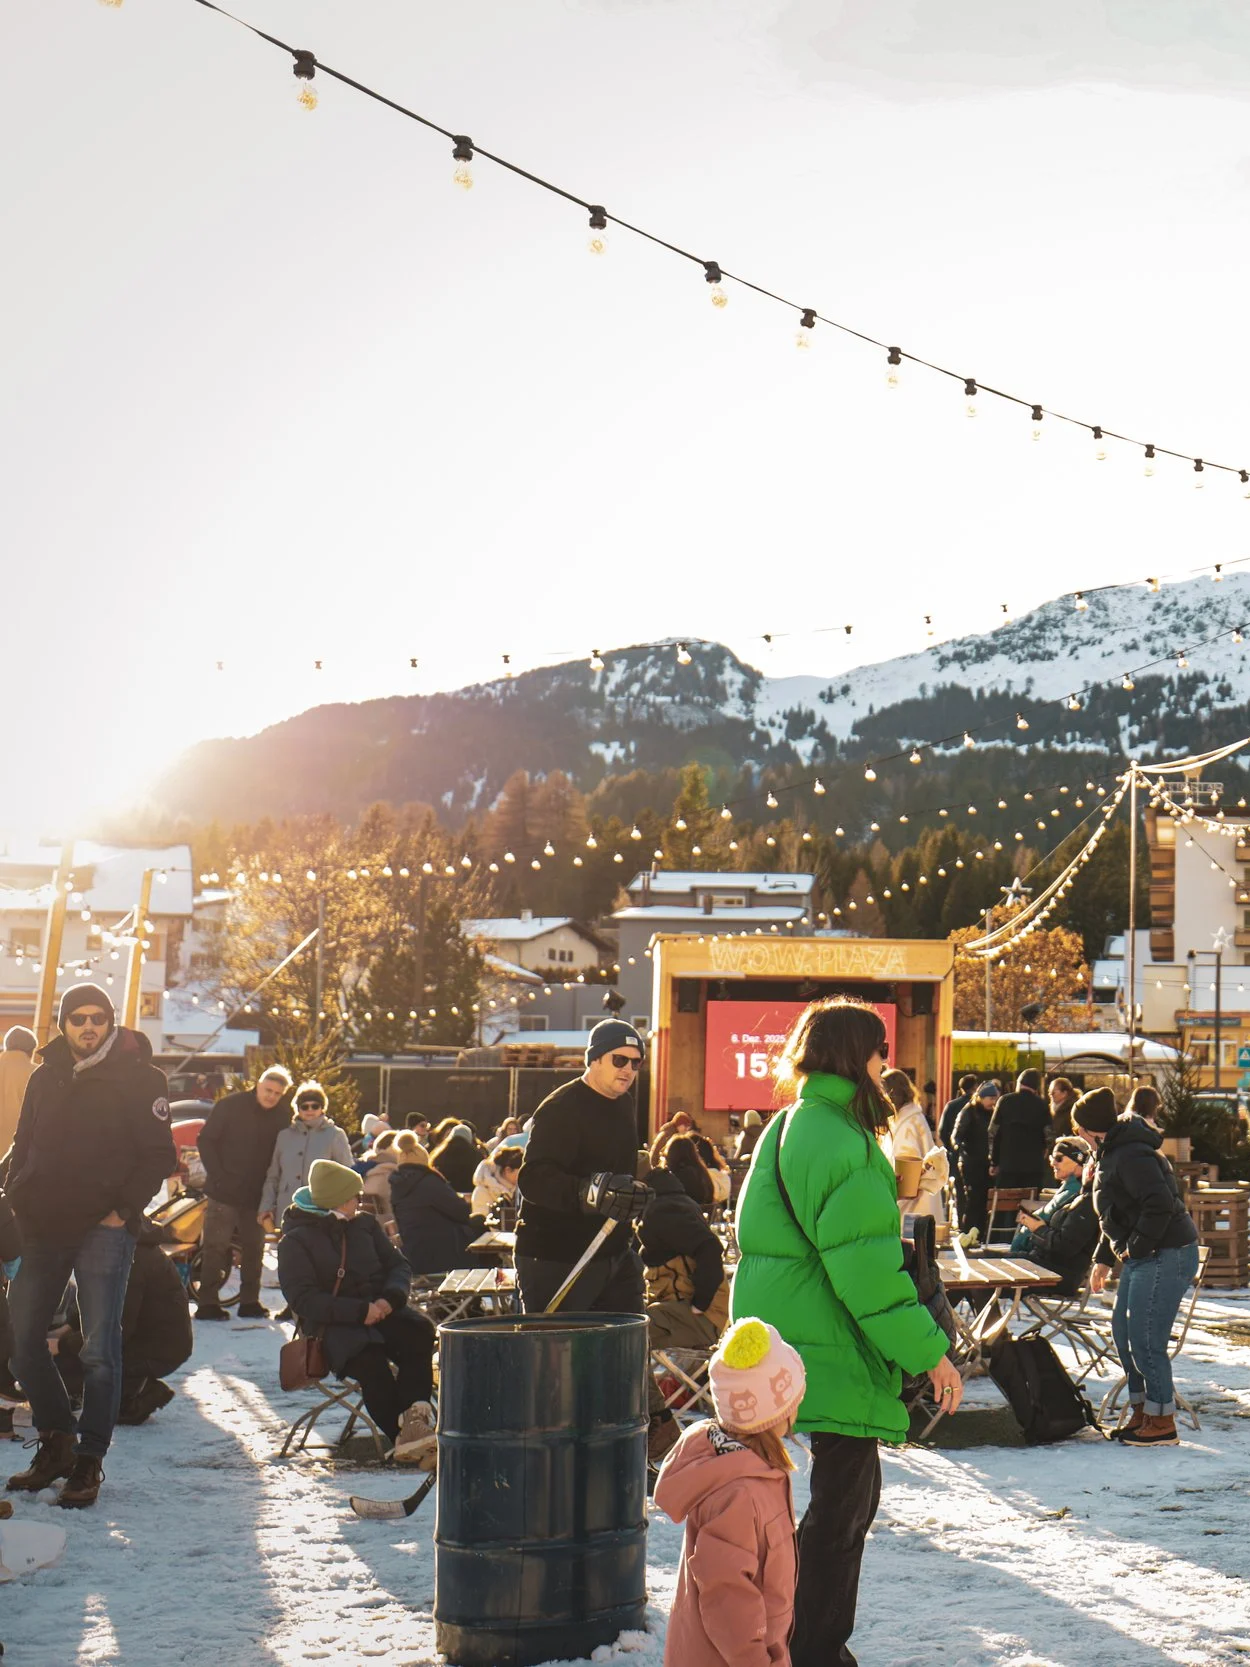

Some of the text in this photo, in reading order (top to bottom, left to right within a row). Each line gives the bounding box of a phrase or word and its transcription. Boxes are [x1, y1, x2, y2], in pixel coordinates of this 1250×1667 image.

[818, 945, 907, 975] PLAZA
[731, 1033, 786, 1044] 6. Dez. 2025
